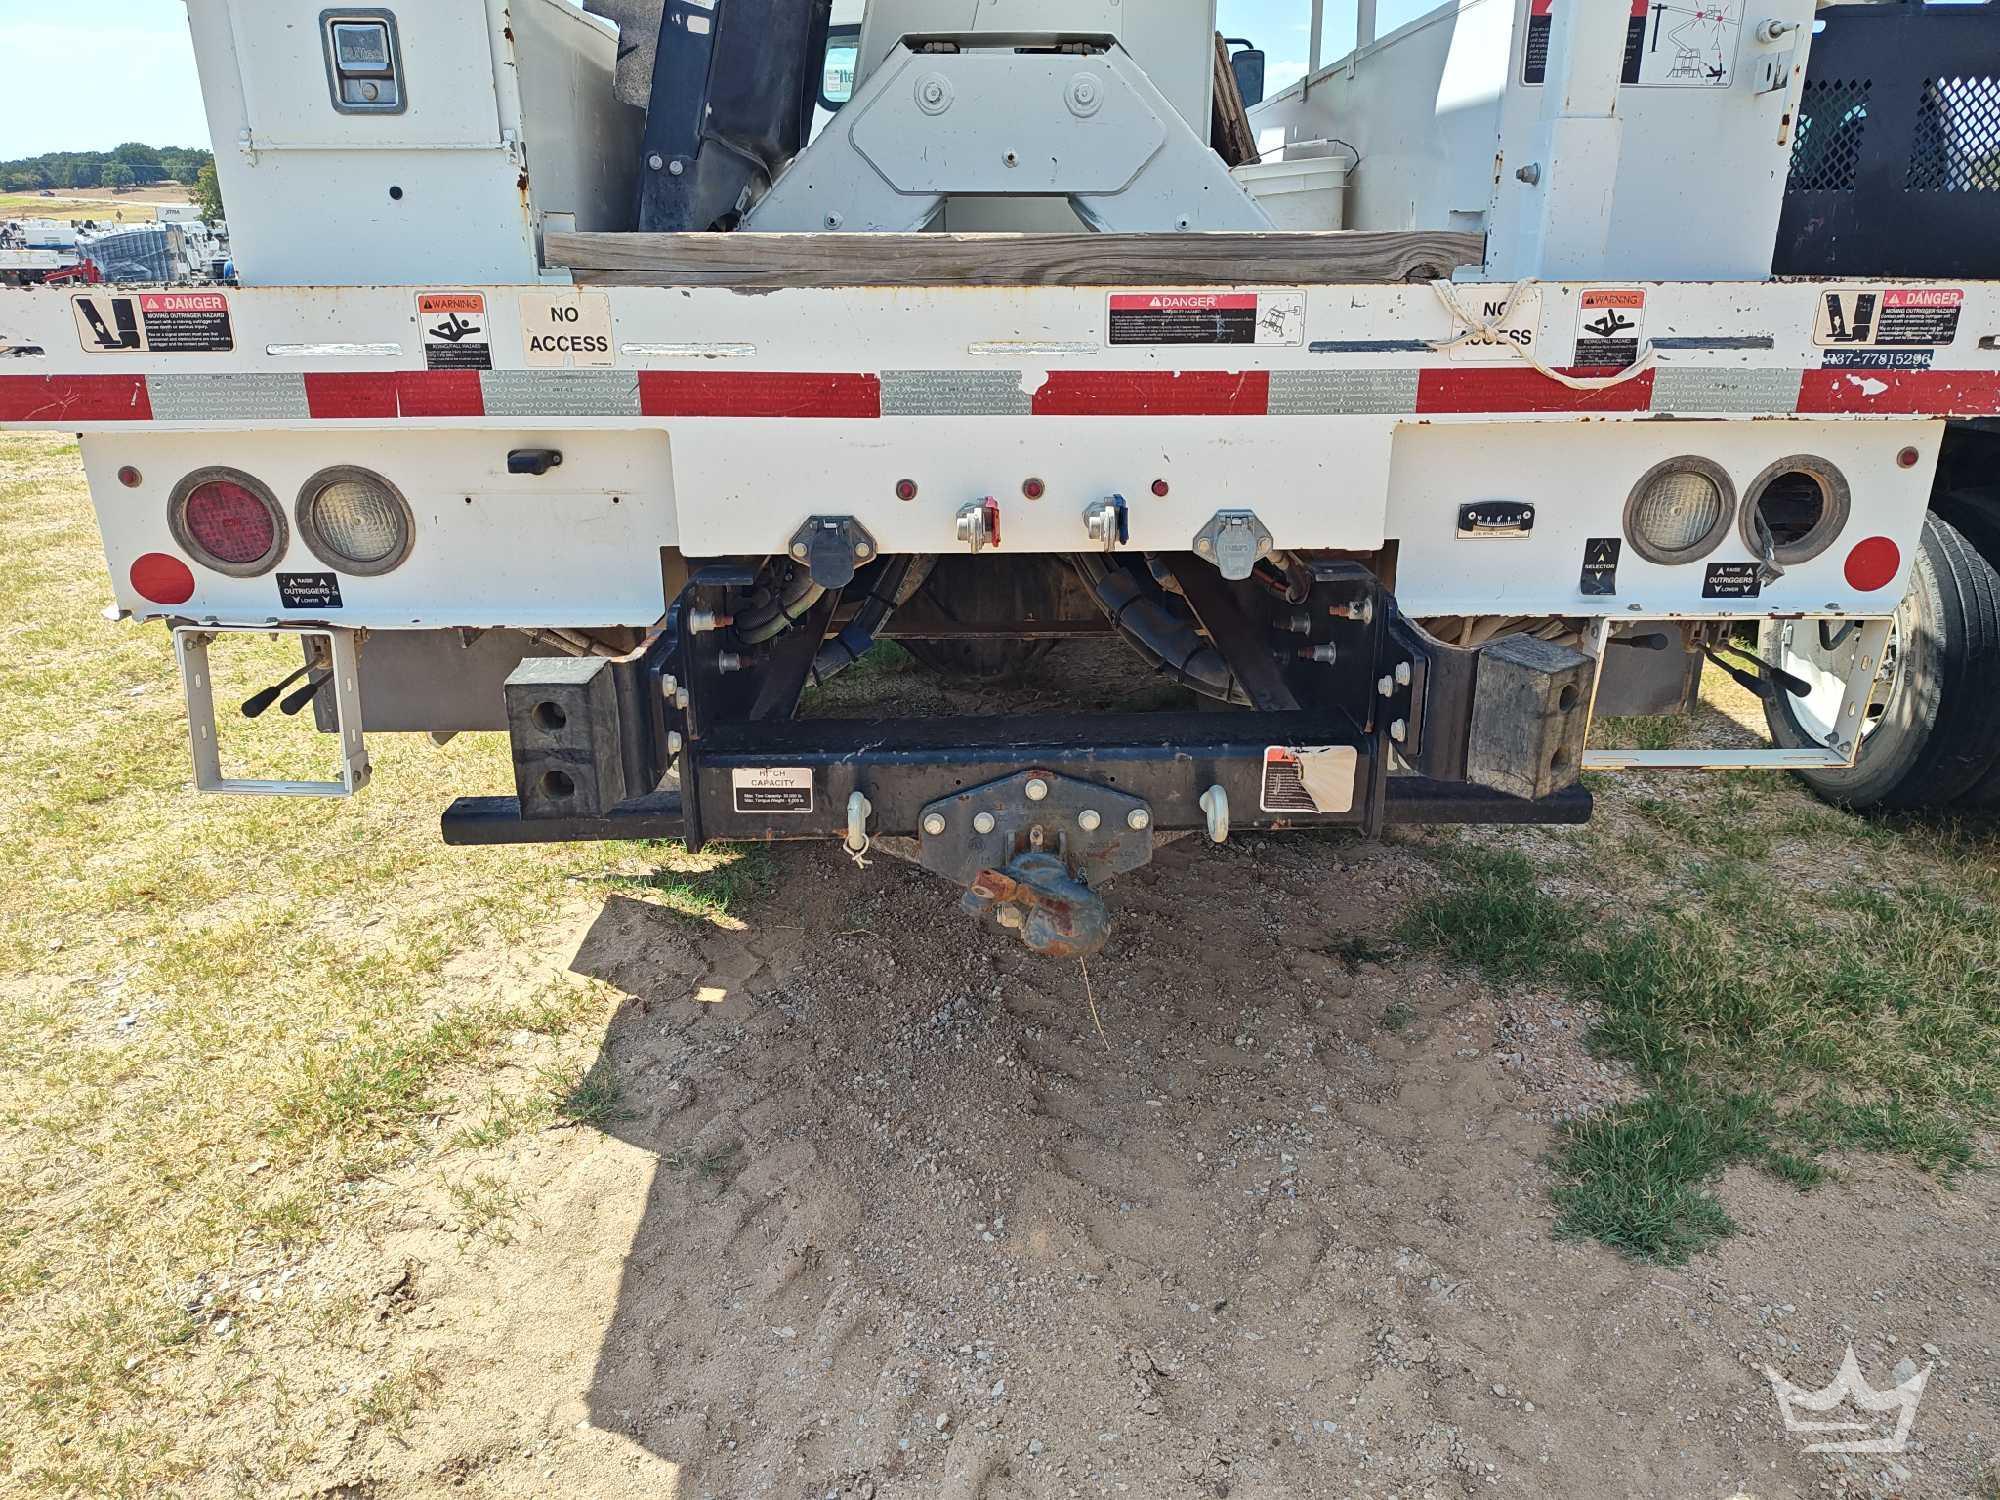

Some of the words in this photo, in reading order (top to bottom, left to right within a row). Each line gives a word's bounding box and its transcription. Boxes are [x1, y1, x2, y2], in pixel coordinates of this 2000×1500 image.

[165, 297, 222, 309] DANGER
[432, 299, 478, 309] WARNING
[1162, 297, 1216, 307] DANGER
[1595, 296, 1638, 305] WARNING
[1906, 292, 1959, 305] DANGER
[551, 307, 579, 322] NO
[1459, 329, 1532, 346] ESS
[530, 336, 608, 352] ACCESS
[284, 587, 330, 595] OUTRIGGERS
